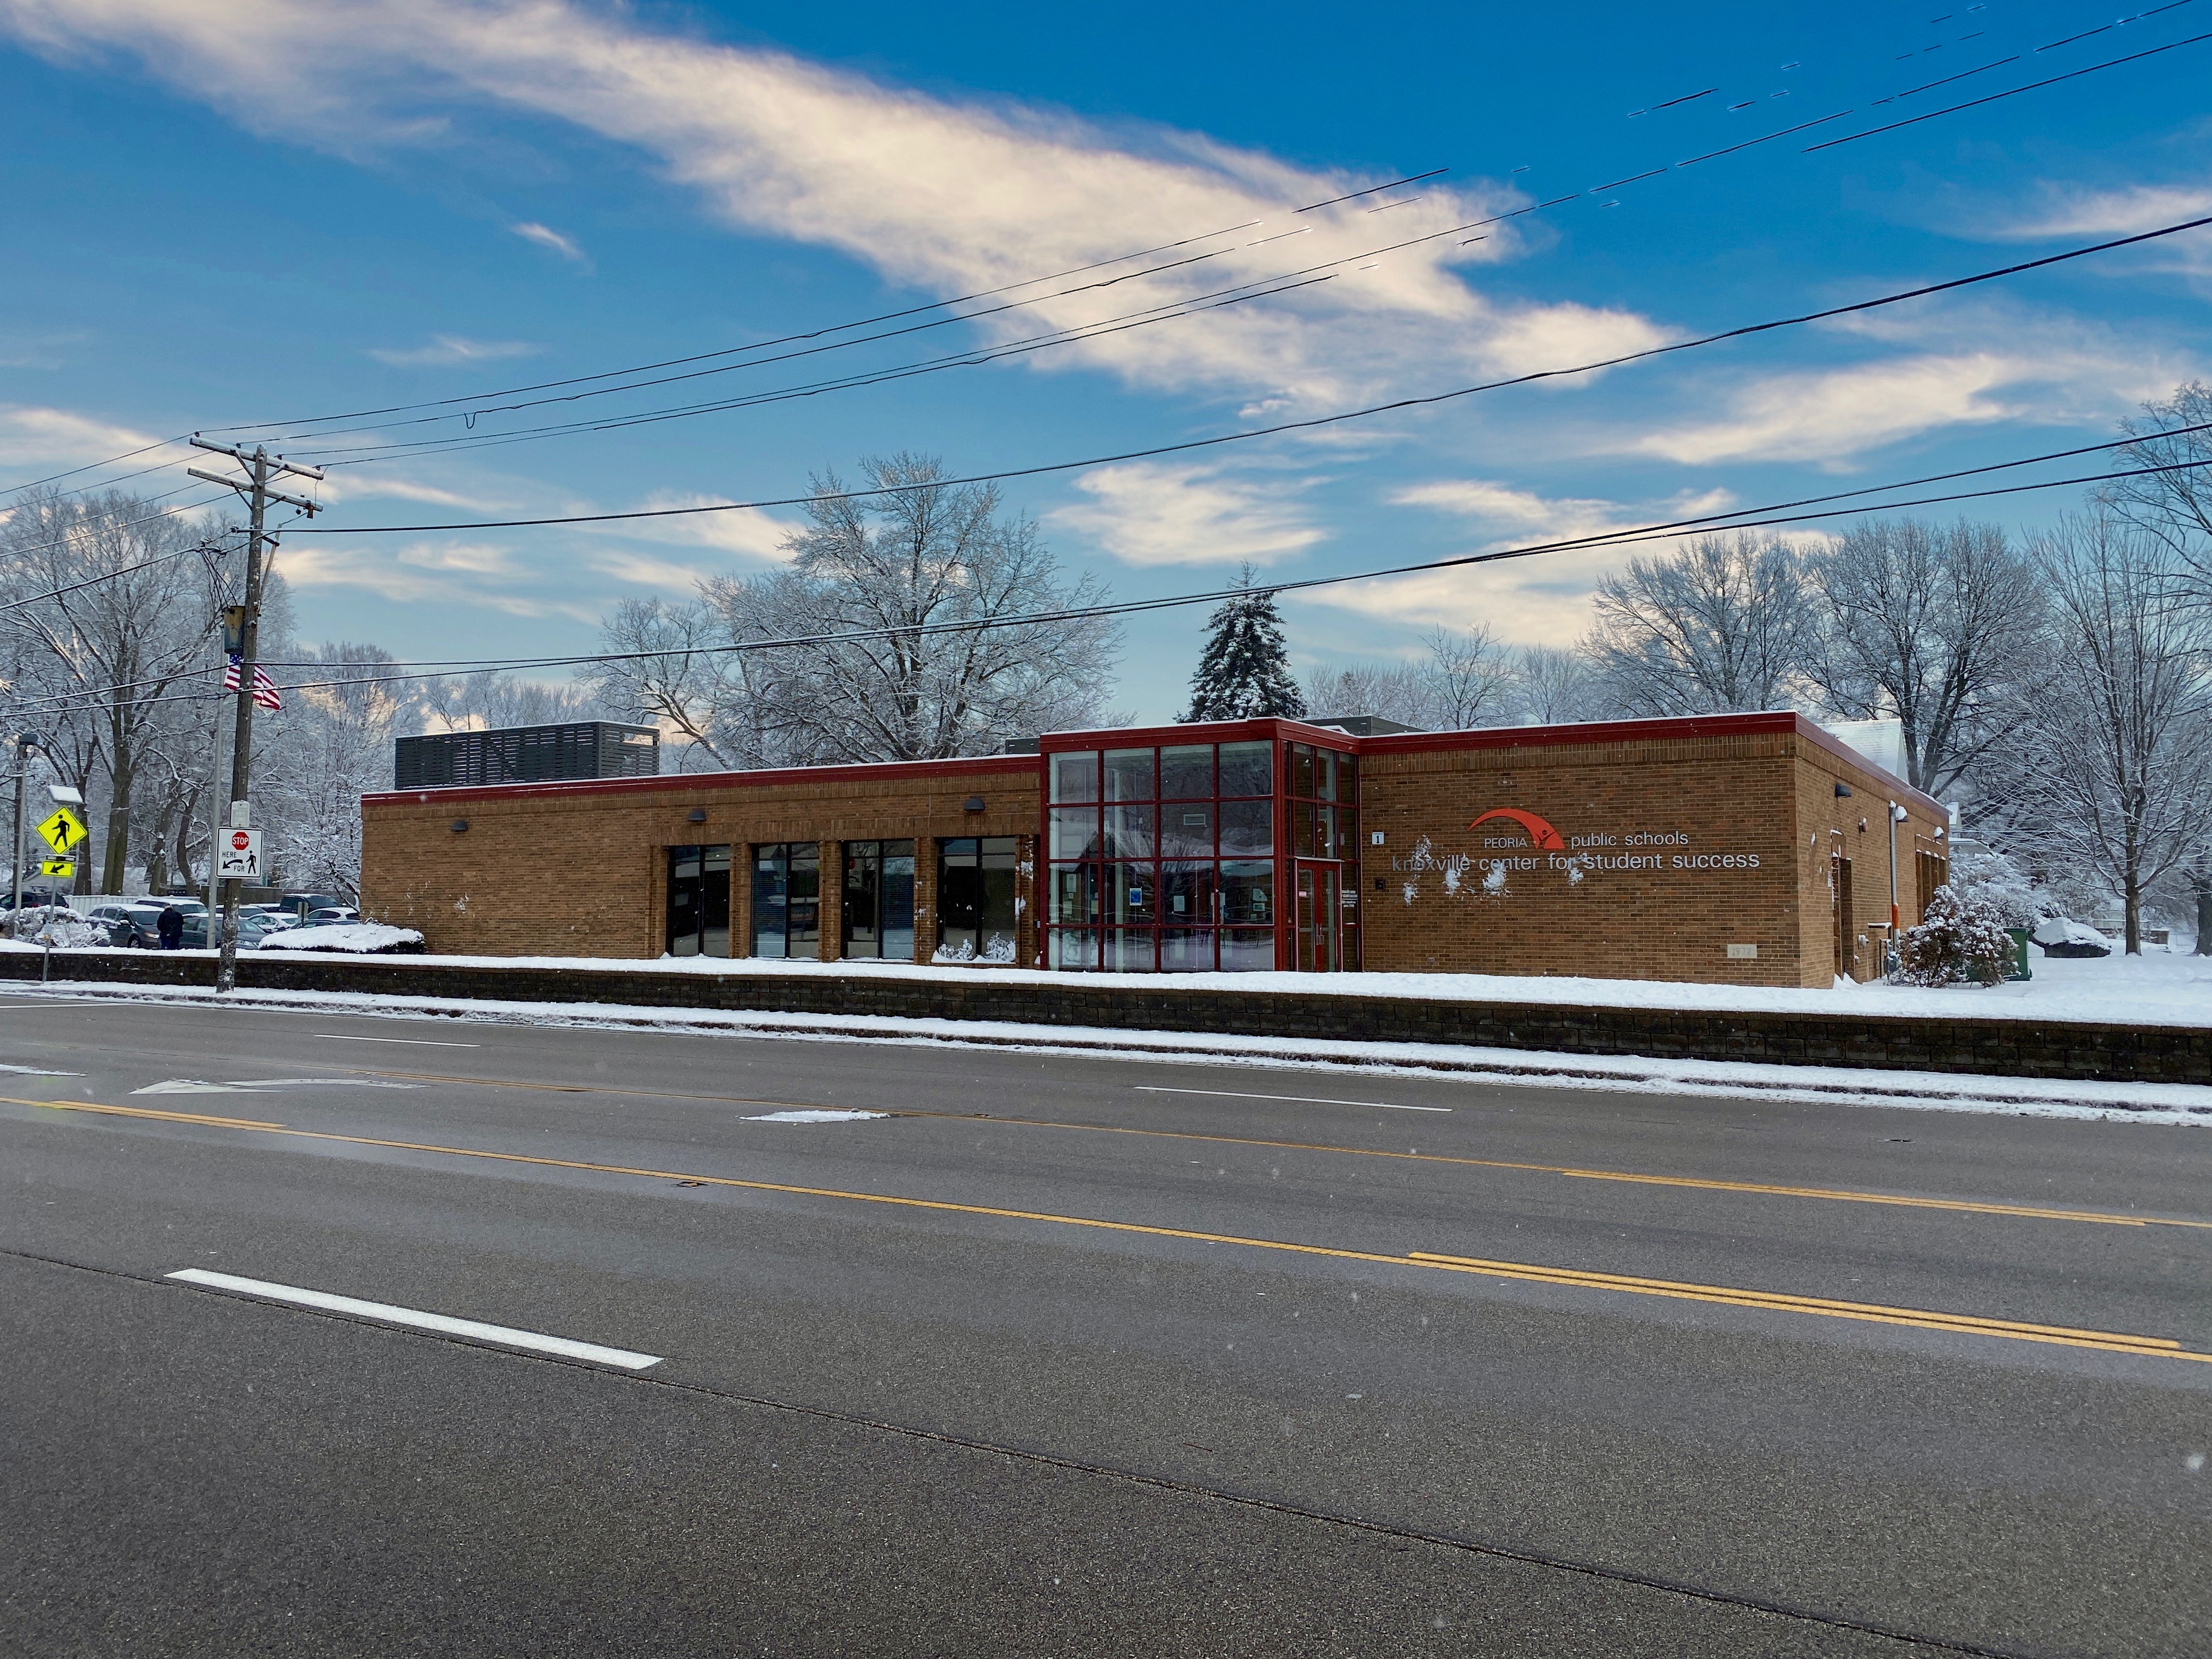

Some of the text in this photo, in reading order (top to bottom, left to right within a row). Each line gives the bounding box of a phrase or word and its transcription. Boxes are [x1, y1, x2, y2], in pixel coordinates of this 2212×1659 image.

[232, 837, 249, 845] STOP
[1376, 835, 1380, 844] 1
[1485, 831, 1689, 849] PEORIA public schools
[1479, 856, 1540, 871] center
[1548, 853, 1576, 870] for
[1584, 851, 1663, 870] student
[1672, 854, 1760, 868] success
